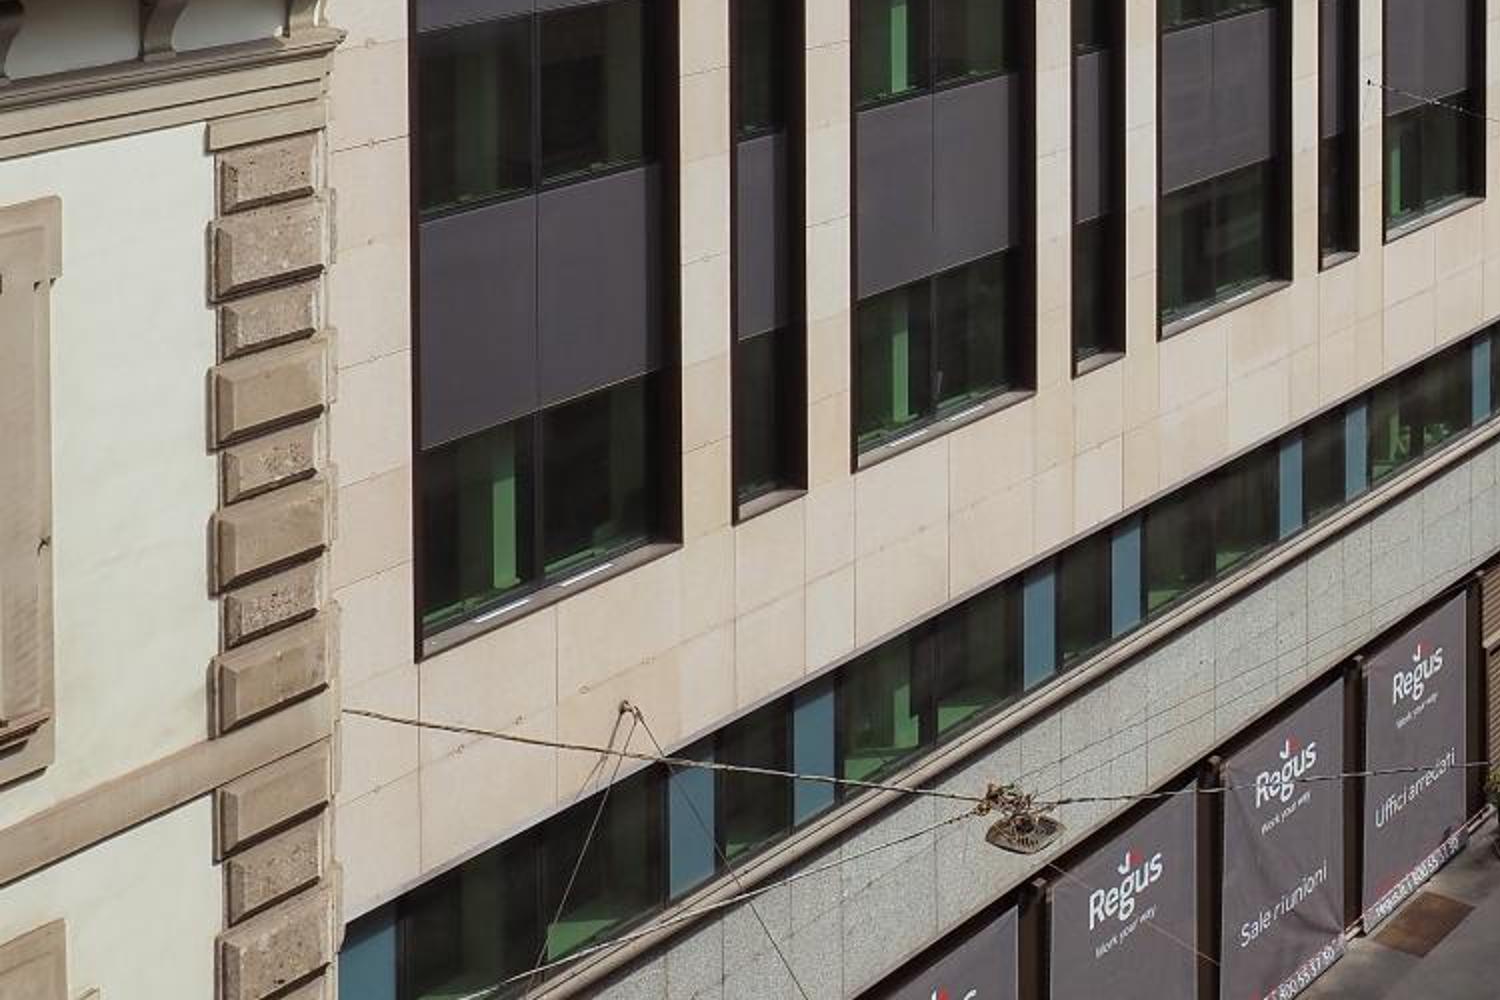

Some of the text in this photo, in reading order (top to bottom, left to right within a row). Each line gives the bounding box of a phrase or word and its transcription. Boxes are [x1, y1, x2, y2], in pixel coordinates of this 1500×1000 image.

[1393, 647, 1444, 705] Regus
[1255, 741, 1317, 808] Regus
[1375, 785, 1407, 828] Uffici
[1089, 852, 1163, 931] Regus
[1240, 857, 1328, 948] Sale riunioni
